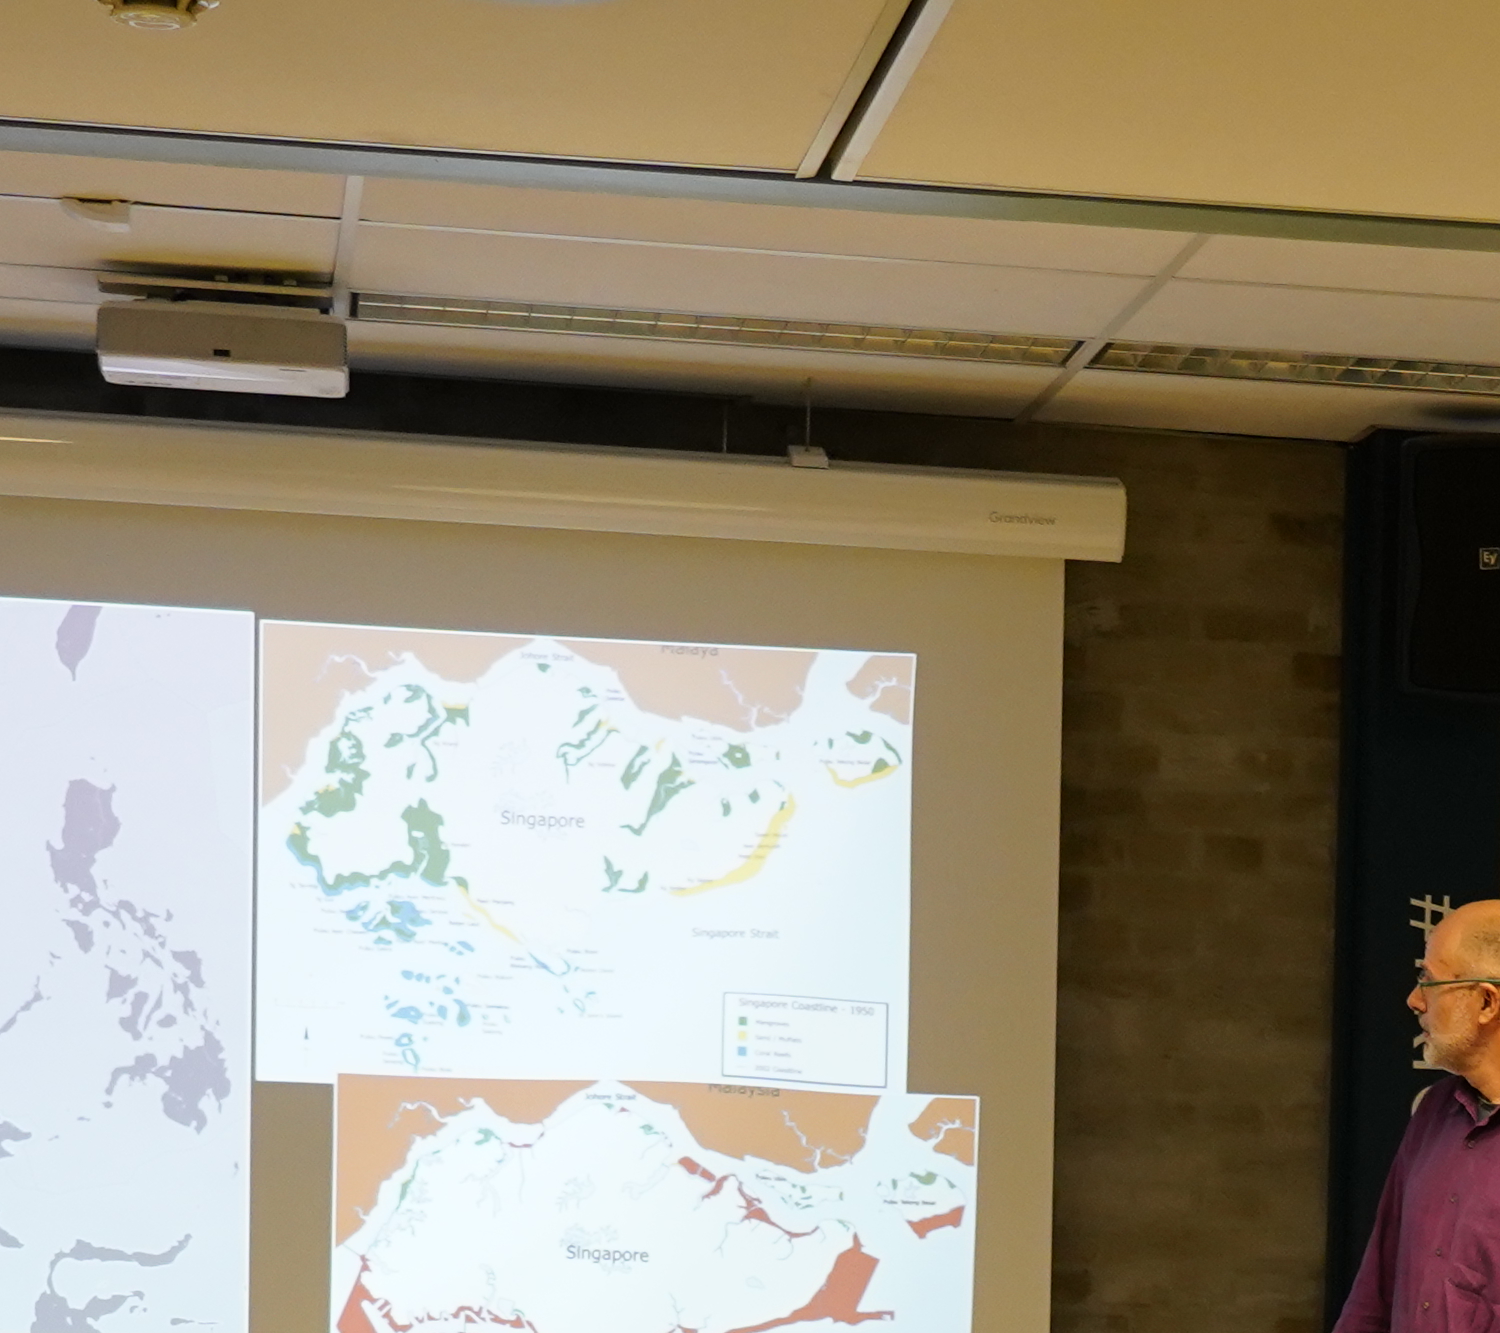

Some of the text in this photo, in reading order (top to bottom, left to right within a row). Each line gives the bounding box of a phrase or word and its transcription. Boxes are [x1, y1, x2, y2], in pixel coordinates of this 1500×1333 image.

[501, 810, 586, 830] Singapore
[691, 927, 780, 940] Singapore Strait
[738, 998, 788, 1009] Singapore
[792, 1001, 838, 1013] Coastline
[850, 1005, 875, 1016] 1950
[566, 1244, 650, 1266] Singapore
